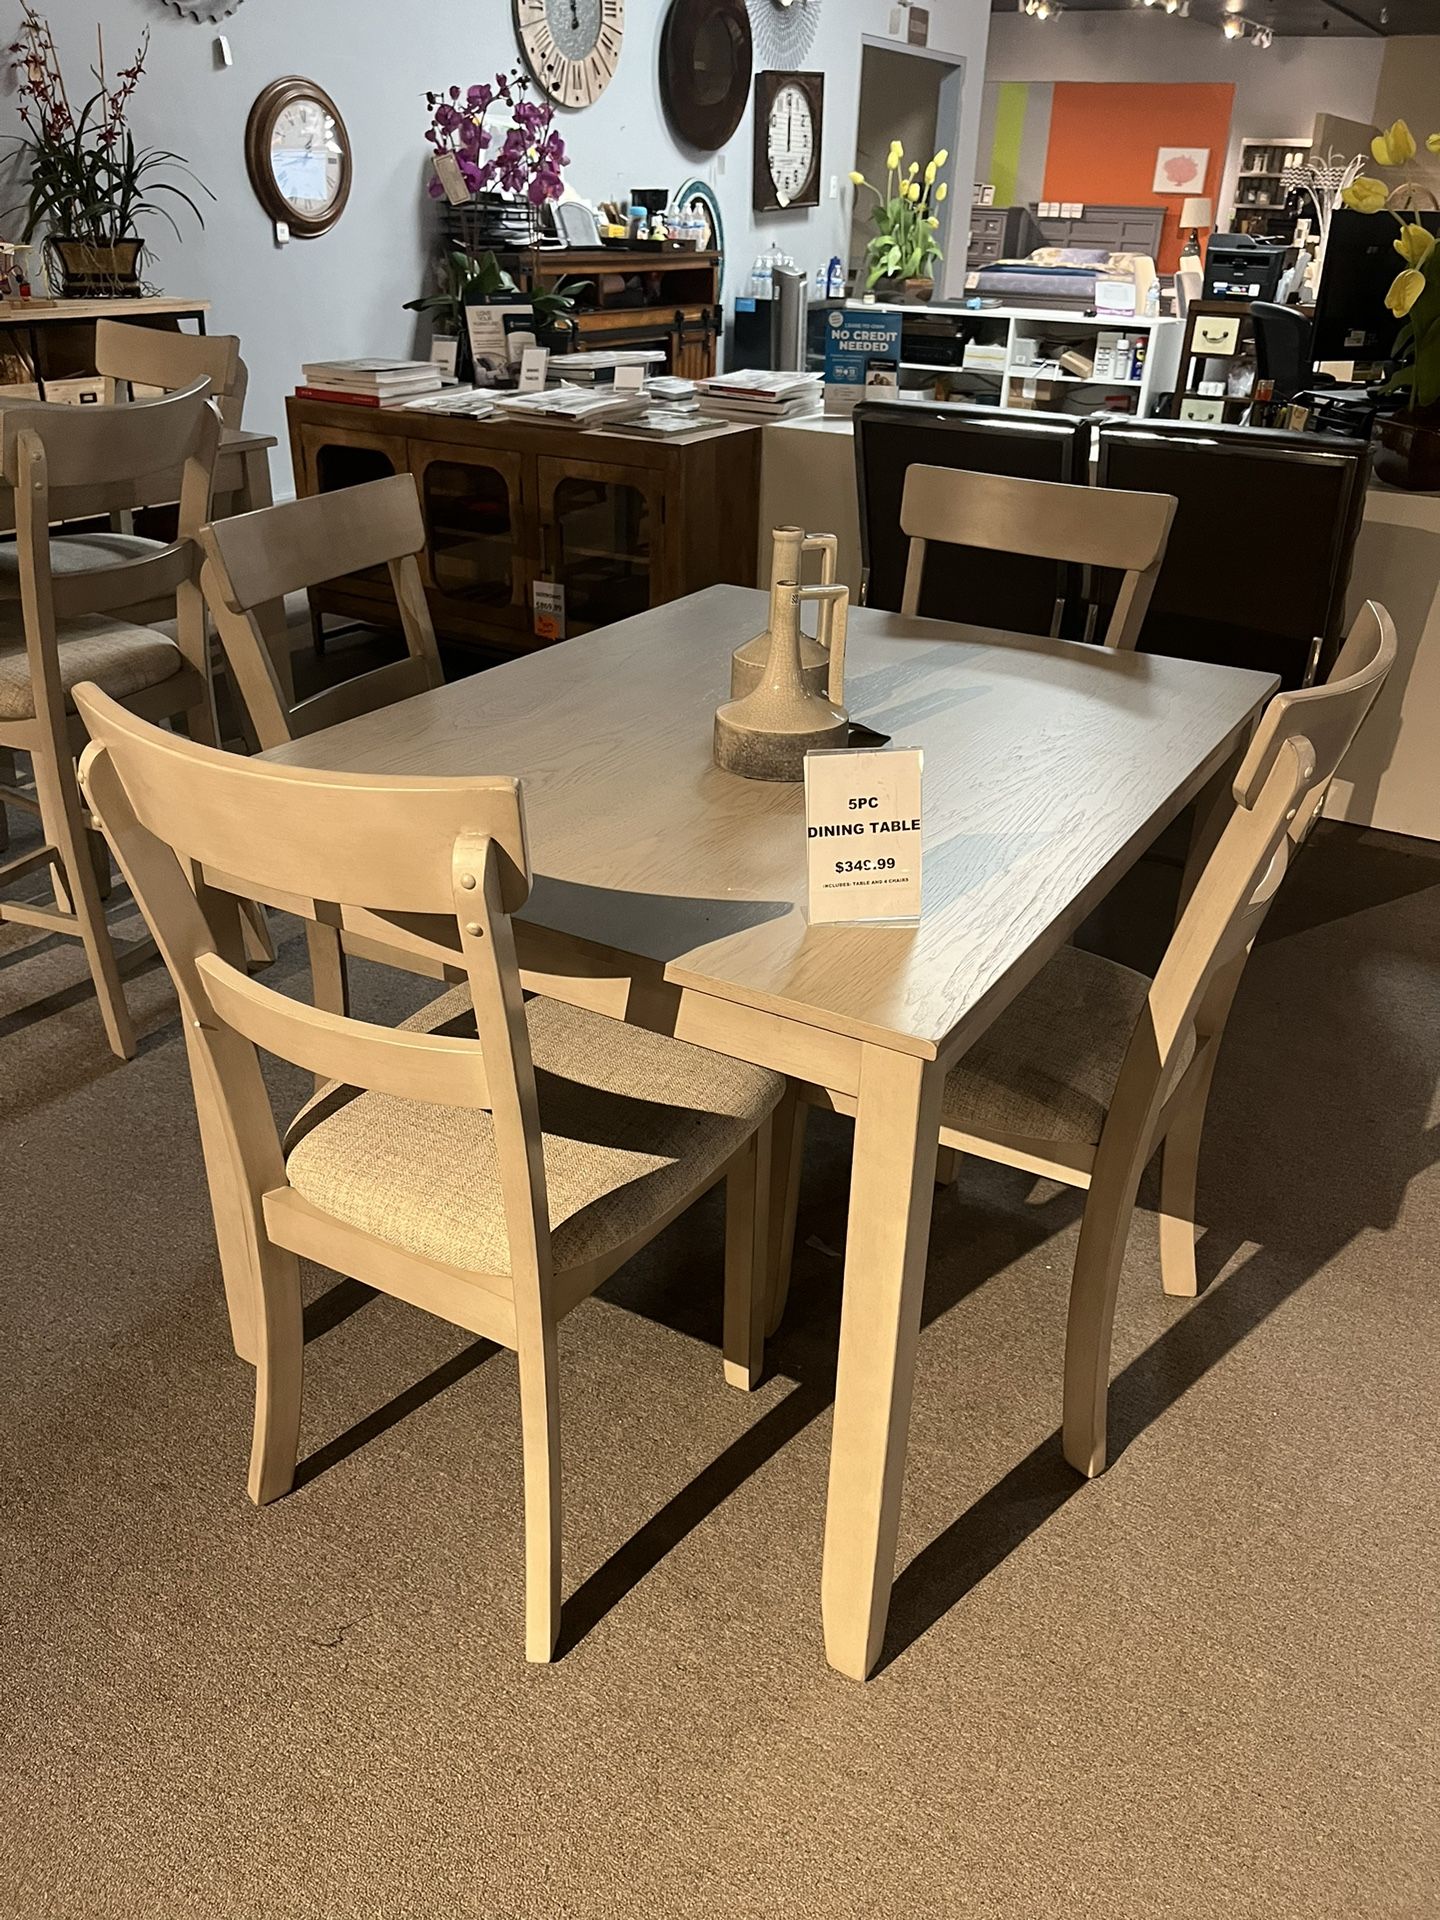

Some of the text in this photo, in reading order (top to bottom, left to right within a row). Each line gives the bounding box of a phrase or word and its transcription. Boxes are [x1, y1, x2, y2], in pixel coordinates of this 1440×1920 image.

[831, 329, 898, 342] NO CREDIT
[839, 341, 889, 352] NEEDED
[848, 797, 879, 810] 5PC
[808, 819, 921, 838] DINING TABLE
